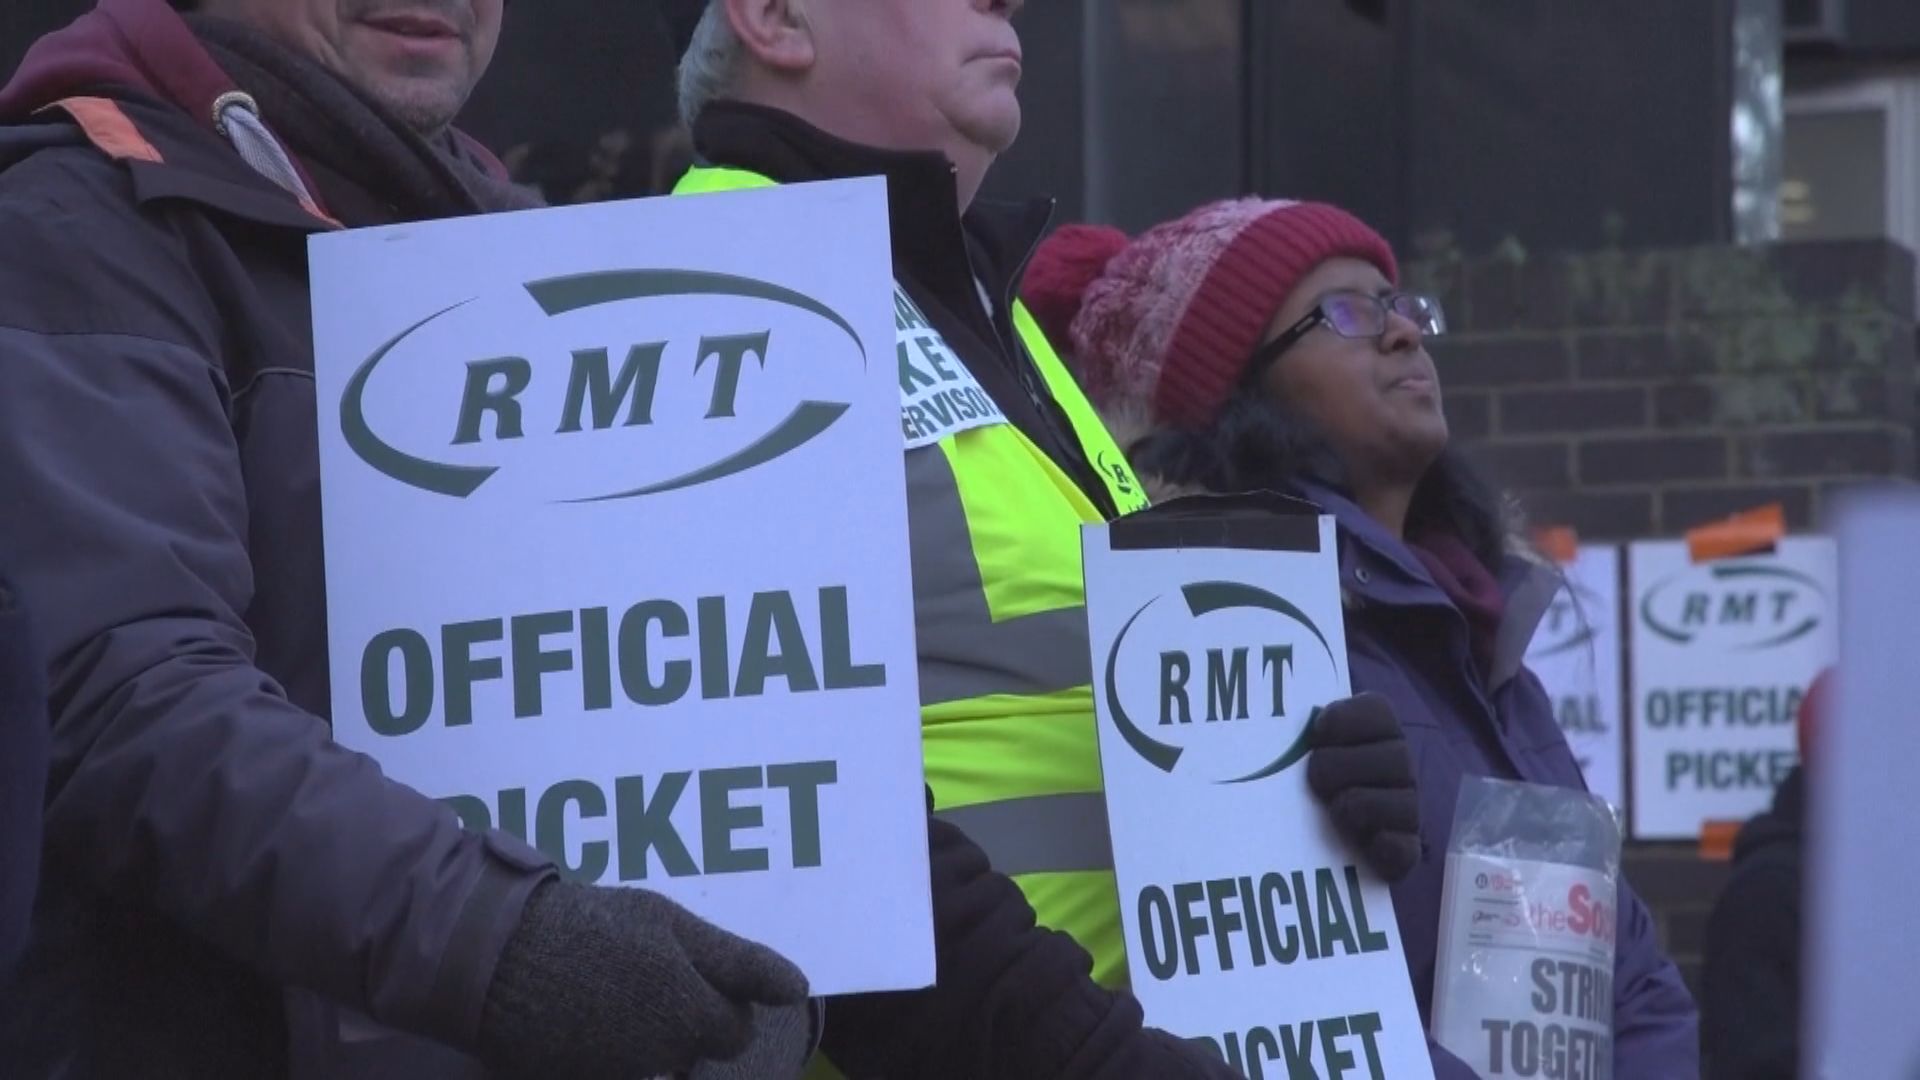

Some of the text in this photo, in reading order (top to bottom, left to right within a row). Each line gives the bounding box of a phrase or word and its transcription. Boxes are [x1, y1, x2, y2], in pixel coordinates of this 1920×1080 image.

[450, 329, 771, 445] RMT
[1682, 591, 1798, 626] RMT
[360, 585, 886, 737] OFFICIAL
[1158, 644, 1293, 725] RMT
[1646, 684, 1803, 728] OFFICIA
[1667, 749, 1799, 791] PICKE
[432, 760, 838, 884] ICKET
[1138, 865, 1389, 981] OFFICIAL
[1531, 957, 1613, 1025] STRI
